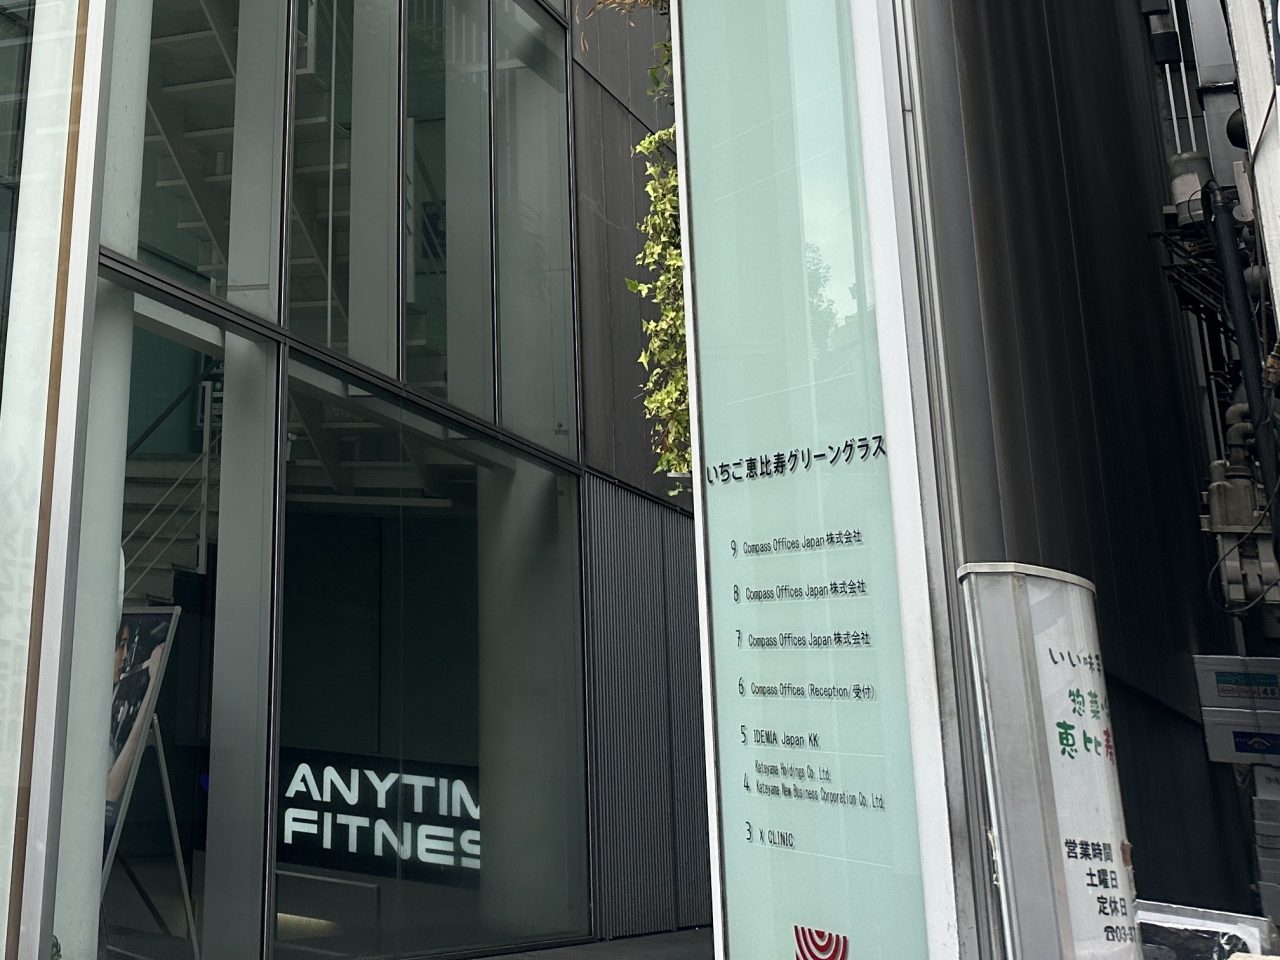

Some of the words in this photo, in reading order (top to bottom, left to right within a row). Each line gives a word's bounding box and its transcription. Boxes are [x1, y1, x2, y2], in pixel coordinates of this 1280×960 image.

[707, 435, 887, 484] いちご恵比寿グリーングラス
[730, 539, 737, 557] 9
[743, 542, 772, 556] Compass
[773, 538, 800, 551] Offices
[802, 535, 825, 550] Japan
[733, 584, 740, 602] 8
[746, 587, 774, 602] Compass
[776, 585, 803, 599] Offices
[805, 583, 829, 599] Japan
[735, 629, 742, 648] 7
[748, 633, 777, 649] Compass
[779, 632, 807, 647] Offices
[809, 632, 832, 648] Japan
[738, 677, 745, 695] 6
[751, 682, 778, 698] Compass
[779, 682, 805, 697] Offices
[740, 724, 747, 744] 5
[781, 731, 805, 748] Japan
[808, 732, 820, 747] KK
[743, 772, 750, 791] 4
[745, 821, 752, 841] 3
[758, 828, 765, 843] X
[767, 829, 795, 848] CLINIC
[1064, 838, 1114, 863] 営業時間
[1086, 867, 1119, 890] 土曜日
[1096, 894, 1128, 917] 定休日
